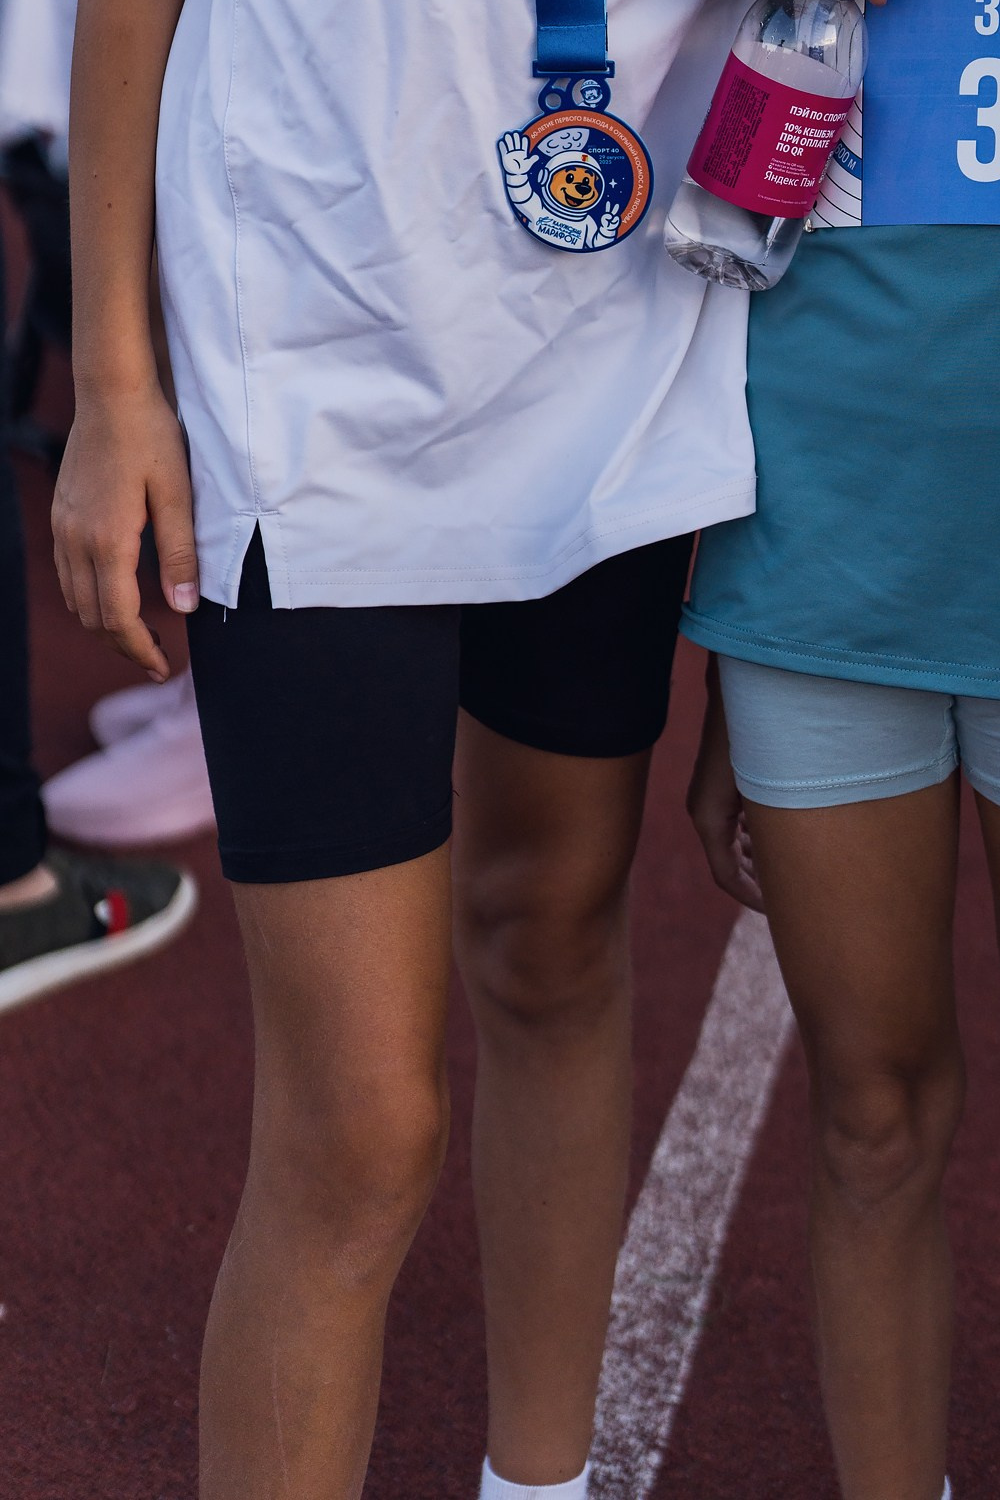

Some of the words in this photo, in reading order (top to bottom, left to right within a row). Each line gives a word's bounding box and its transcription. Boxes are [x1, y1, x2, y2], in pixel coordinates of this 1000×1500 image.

[554, 115, 582, 125] ПЕРВОГО
[789, 105, 811, 118] ПЭЙ
[810, 111, 822, 121] ПО
[583, 116, 609, 129] ВЫХОДА
[784, 122, 802, 135] 10%
[803, 127, 835, 139] КЕШБЭК
[780, 132, 800, 144] ПРИ
[800, 138, 831, 149] ОПЛАТЕ
[775, 142, 791, 153] ПО
[790, 146, 804, 157] QR
[634, 156, 644, 183] КОСМОС
[764, 171, 799, 186] Яндекс
[800, 178, 815, 187] Пэй
[622, 198, 640, 224] ЛЕОНОВА
[537, 225, 578, 245] МАРАФОН
